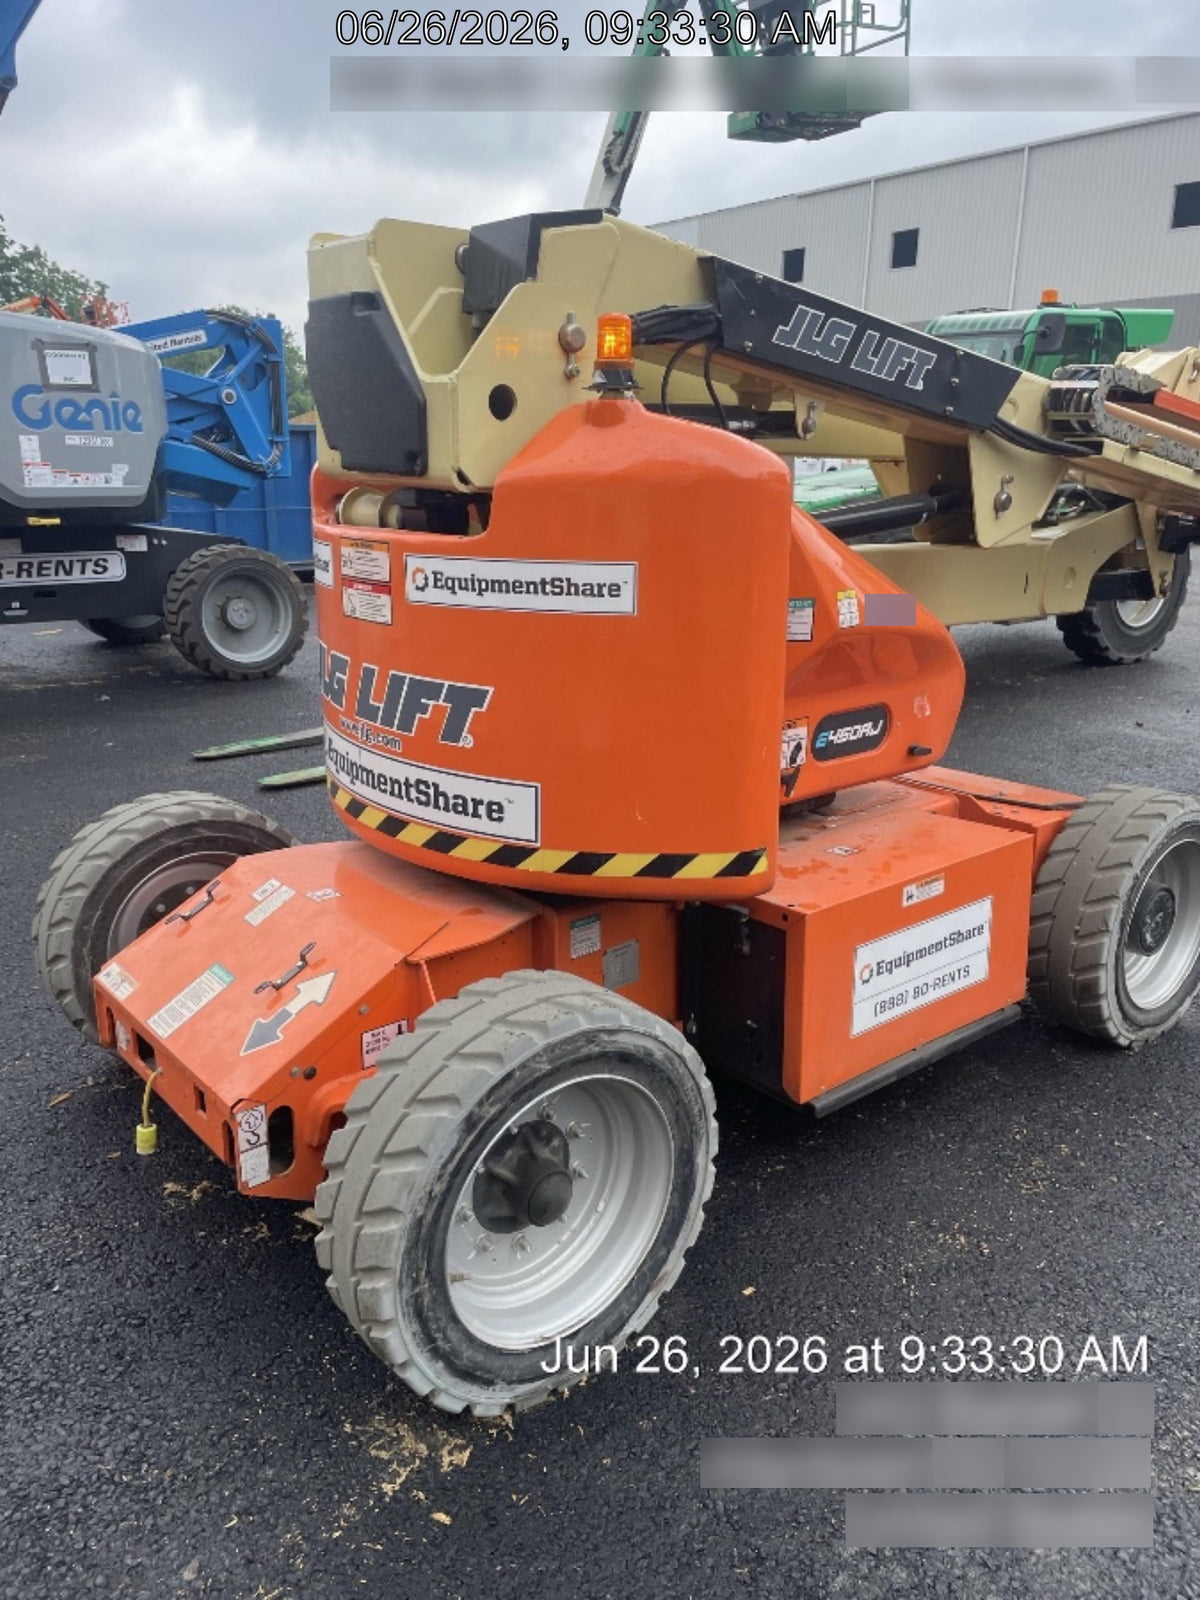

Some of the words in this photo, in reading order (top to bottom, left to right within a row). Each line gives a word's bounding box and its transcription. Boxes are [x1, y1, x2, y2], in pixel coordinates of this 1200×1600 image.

[771, 304, 858, 364] JLG
[850, 329, 938, 390] LIFT
[11, 384, 144, 433] Genie
[0, 557, 110, 580] -RENTS
[431, 570, 623, 599] EquipmentShare
[318, 637, 351, 712] LG
[354, 662, 495, 747] LIFT
[327, 737, 506, 824] EquipmentShare
[875, 923, 985, 977] EquipmentShare
[873, 990, 909, 1018] (888)
